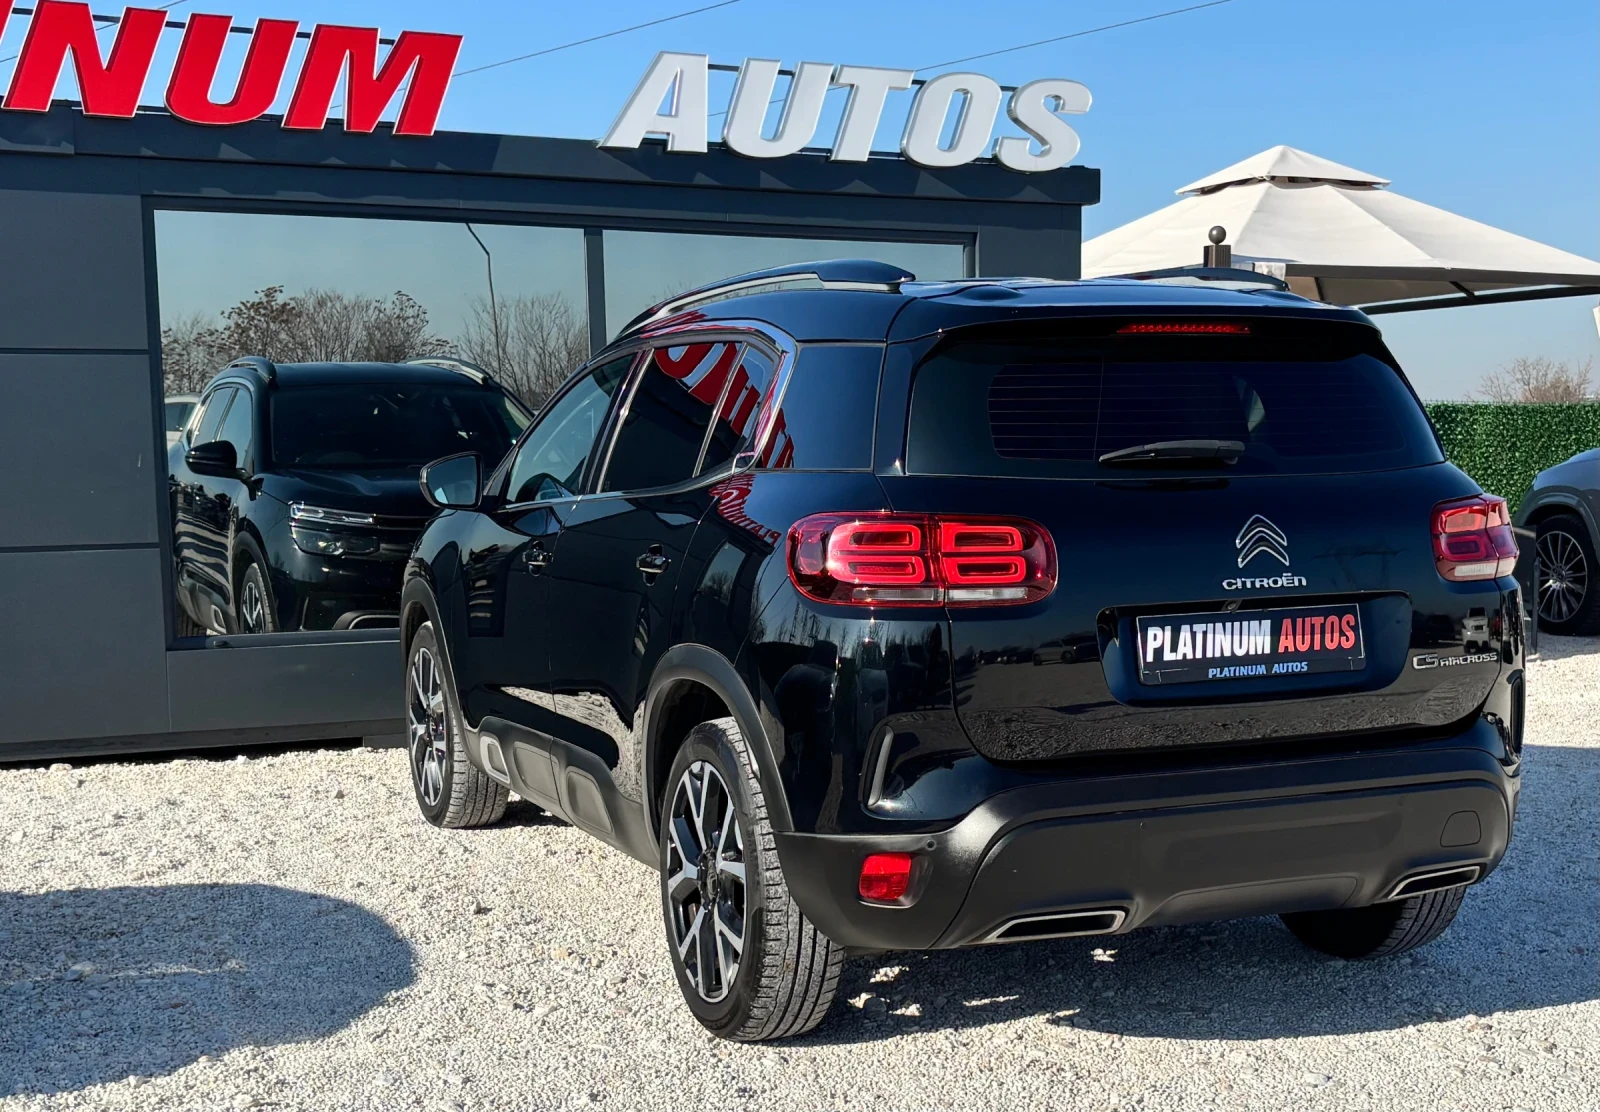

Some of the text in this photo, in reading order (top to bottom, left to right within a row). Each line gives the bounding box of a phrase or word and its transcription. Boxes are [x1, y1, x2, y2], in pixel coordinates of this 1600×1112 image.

[0, 0, 1092, 173] NUM AUTOS
[1146, 614, 1355, 663] PLATINUM AUTOS
[1208, 661, 1308, 679] PLATINUM AUTOS
